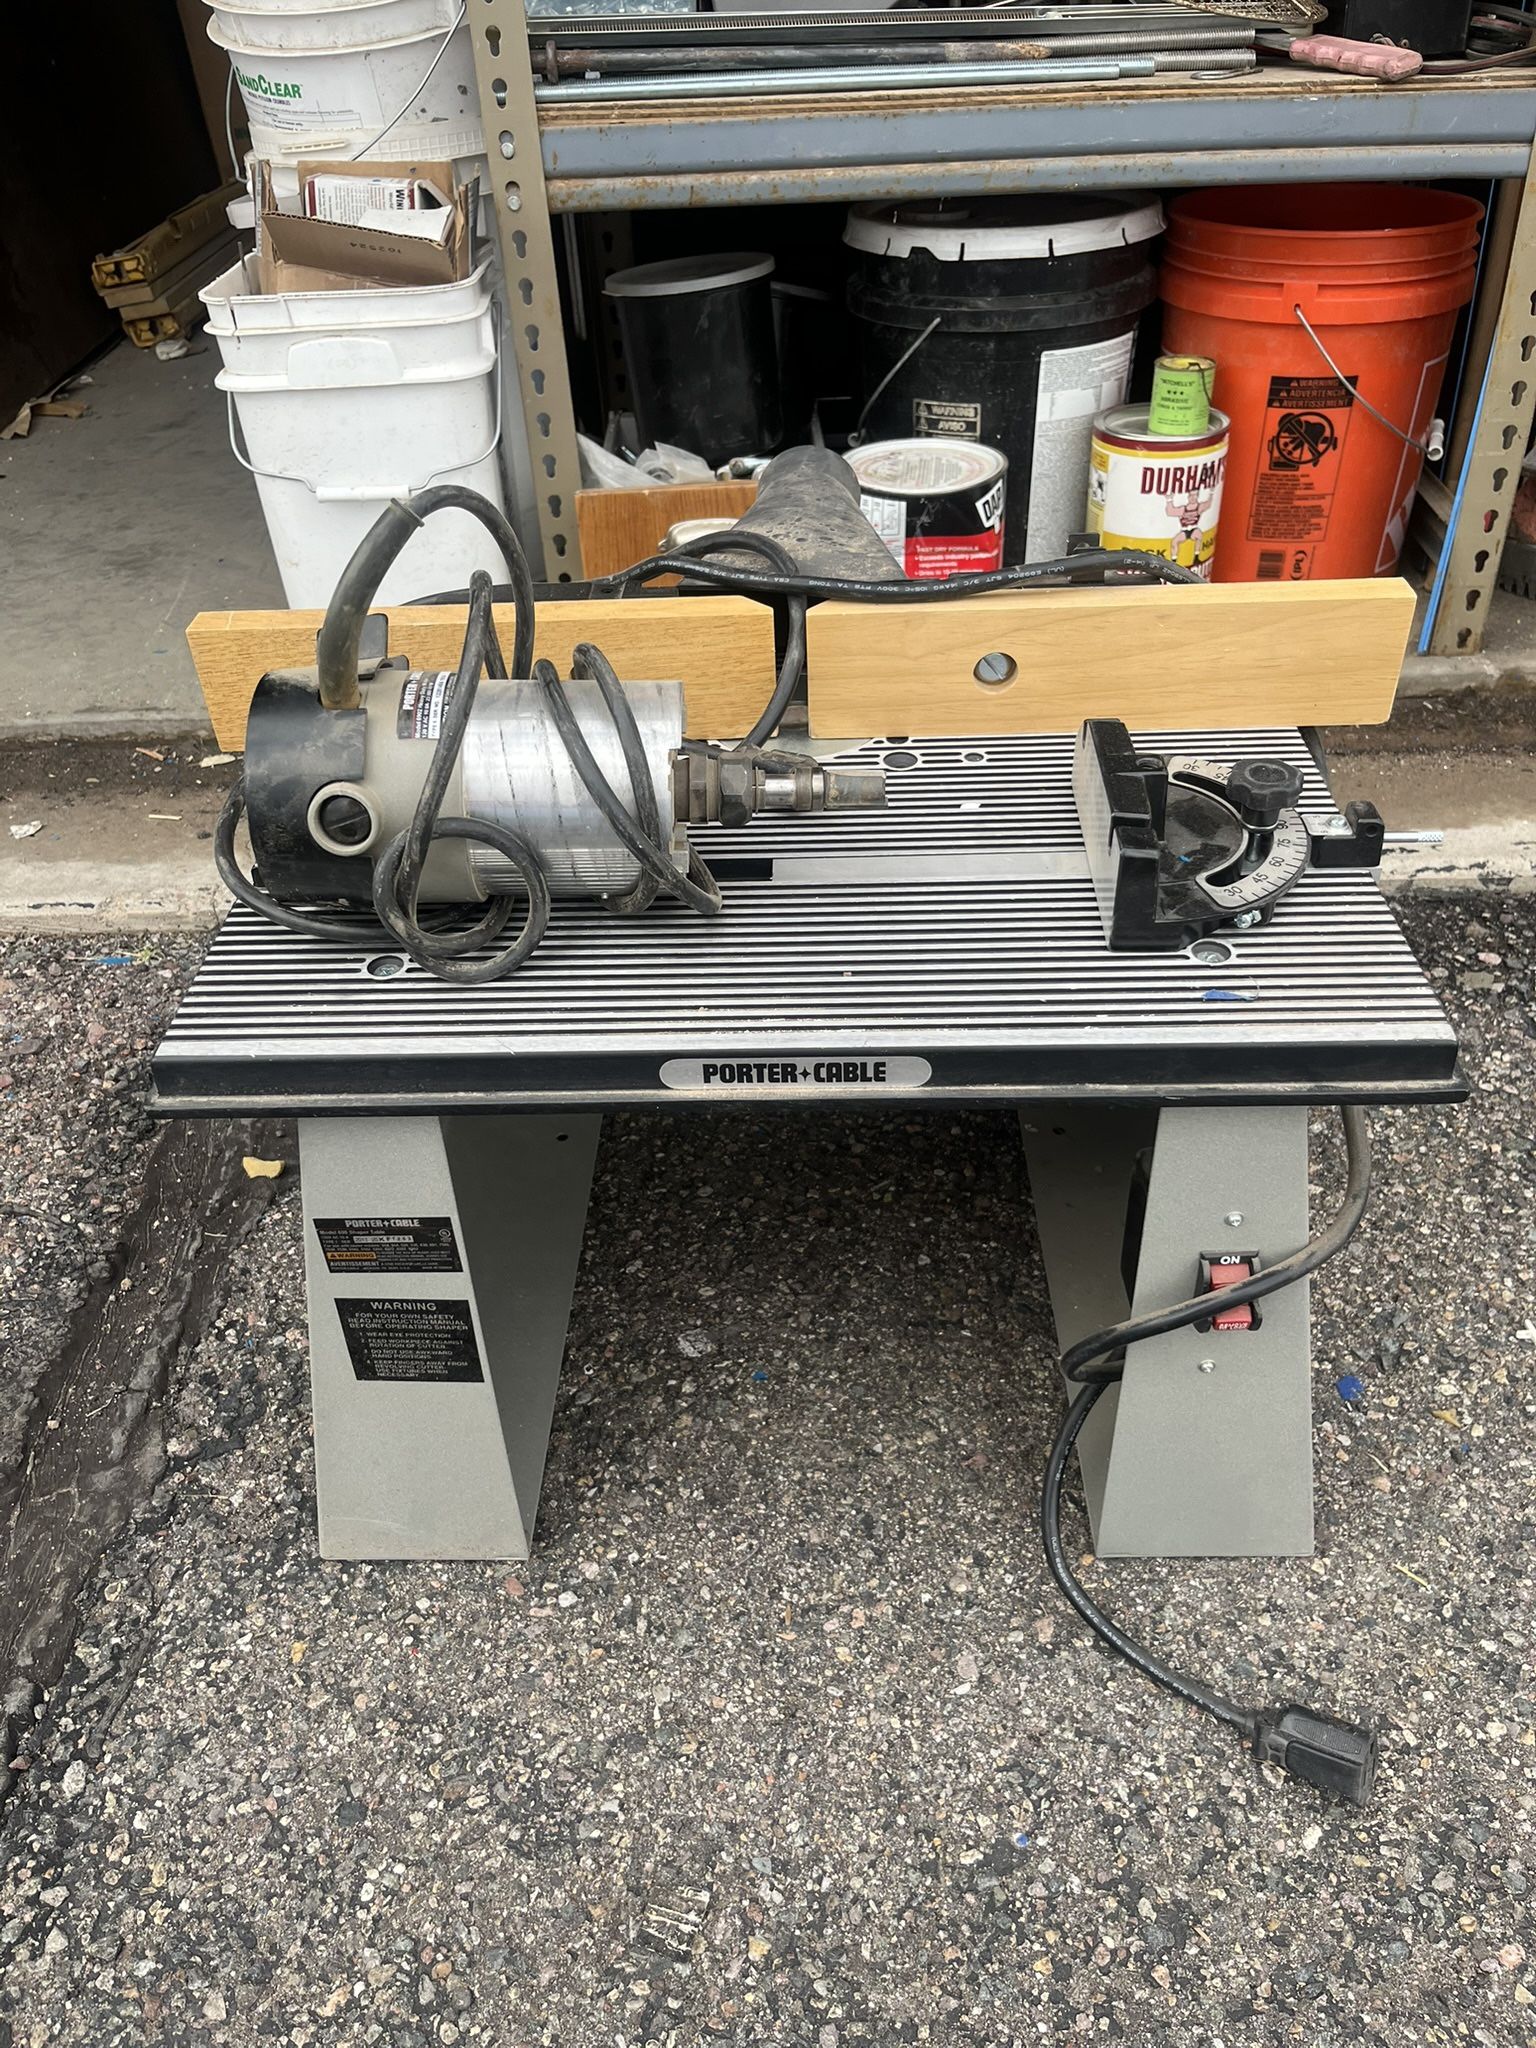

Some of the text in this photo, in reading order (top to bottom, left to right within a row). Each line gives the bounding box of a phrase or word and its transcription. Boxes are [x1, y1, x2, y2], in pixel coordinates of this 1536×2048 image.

[876, 584, 899, 592] 300V
[1276, 819, 1290, 831] 90
[1276, 838, 1291, 849] 75
[1268, 855, 1286, 868] 60
[1252, 871, 1270, 885] 45
[1223, 885, 1243, 898] 30
[1220, 1255, 1241, 1265] ON
[370, 1301, 437, 1311] WARNING
[375, 1312, 399, 1320] YOUR
[385, 1323, 433, 1331] OPERATING
[1148, 1665, 1169, 1682] 300V
